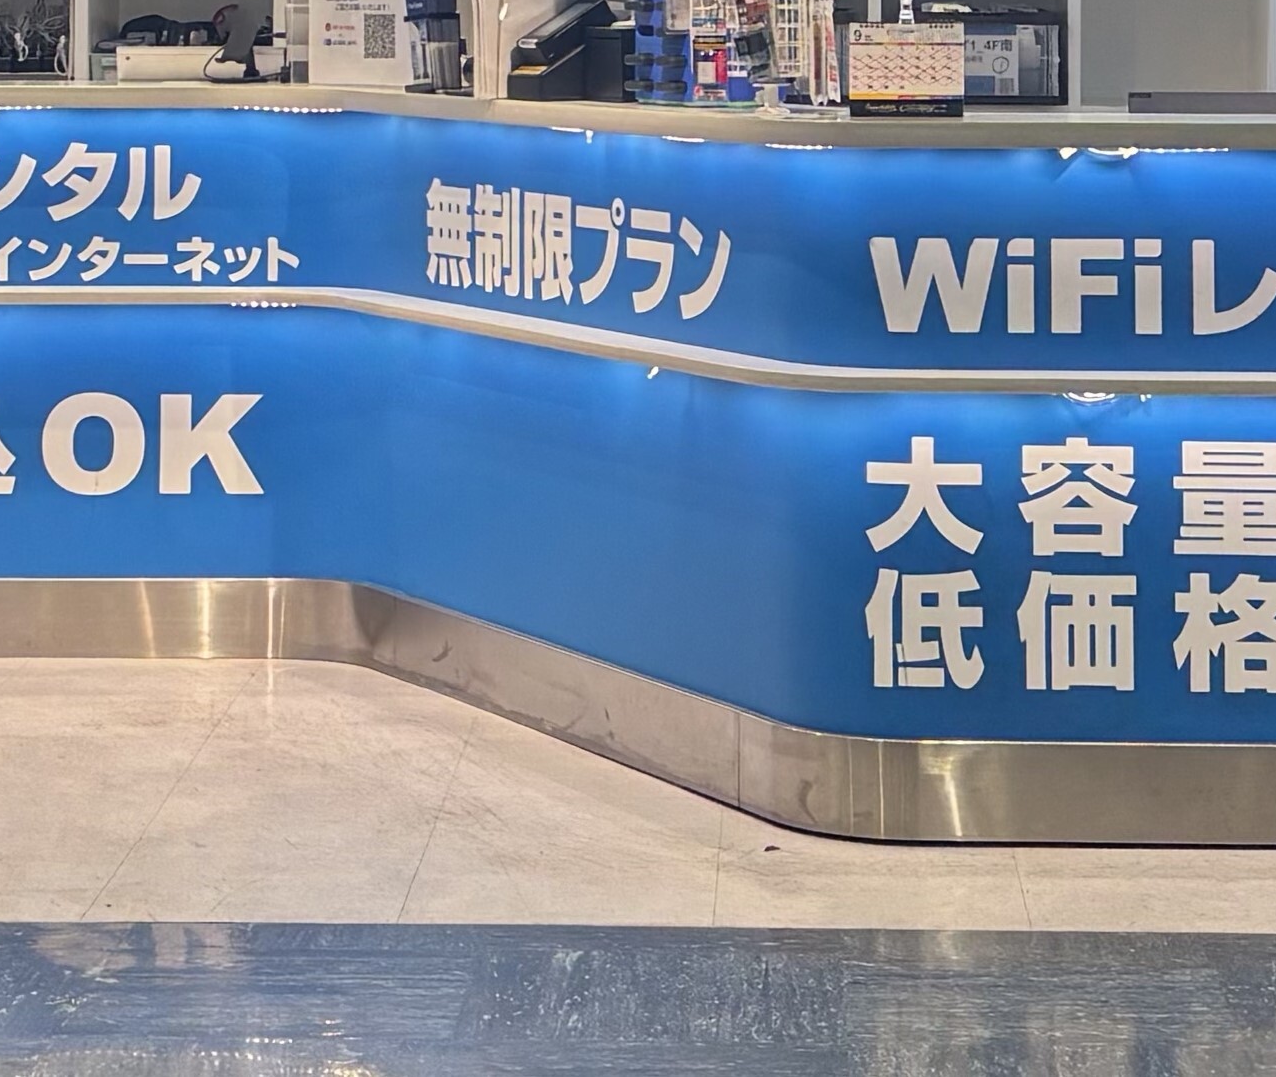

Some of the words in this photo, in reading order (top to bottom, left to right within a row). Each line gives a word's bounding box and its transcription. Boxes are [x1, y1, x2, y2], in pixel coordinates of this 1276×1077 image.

[425, 175, 731, 323] 無制限プラン
